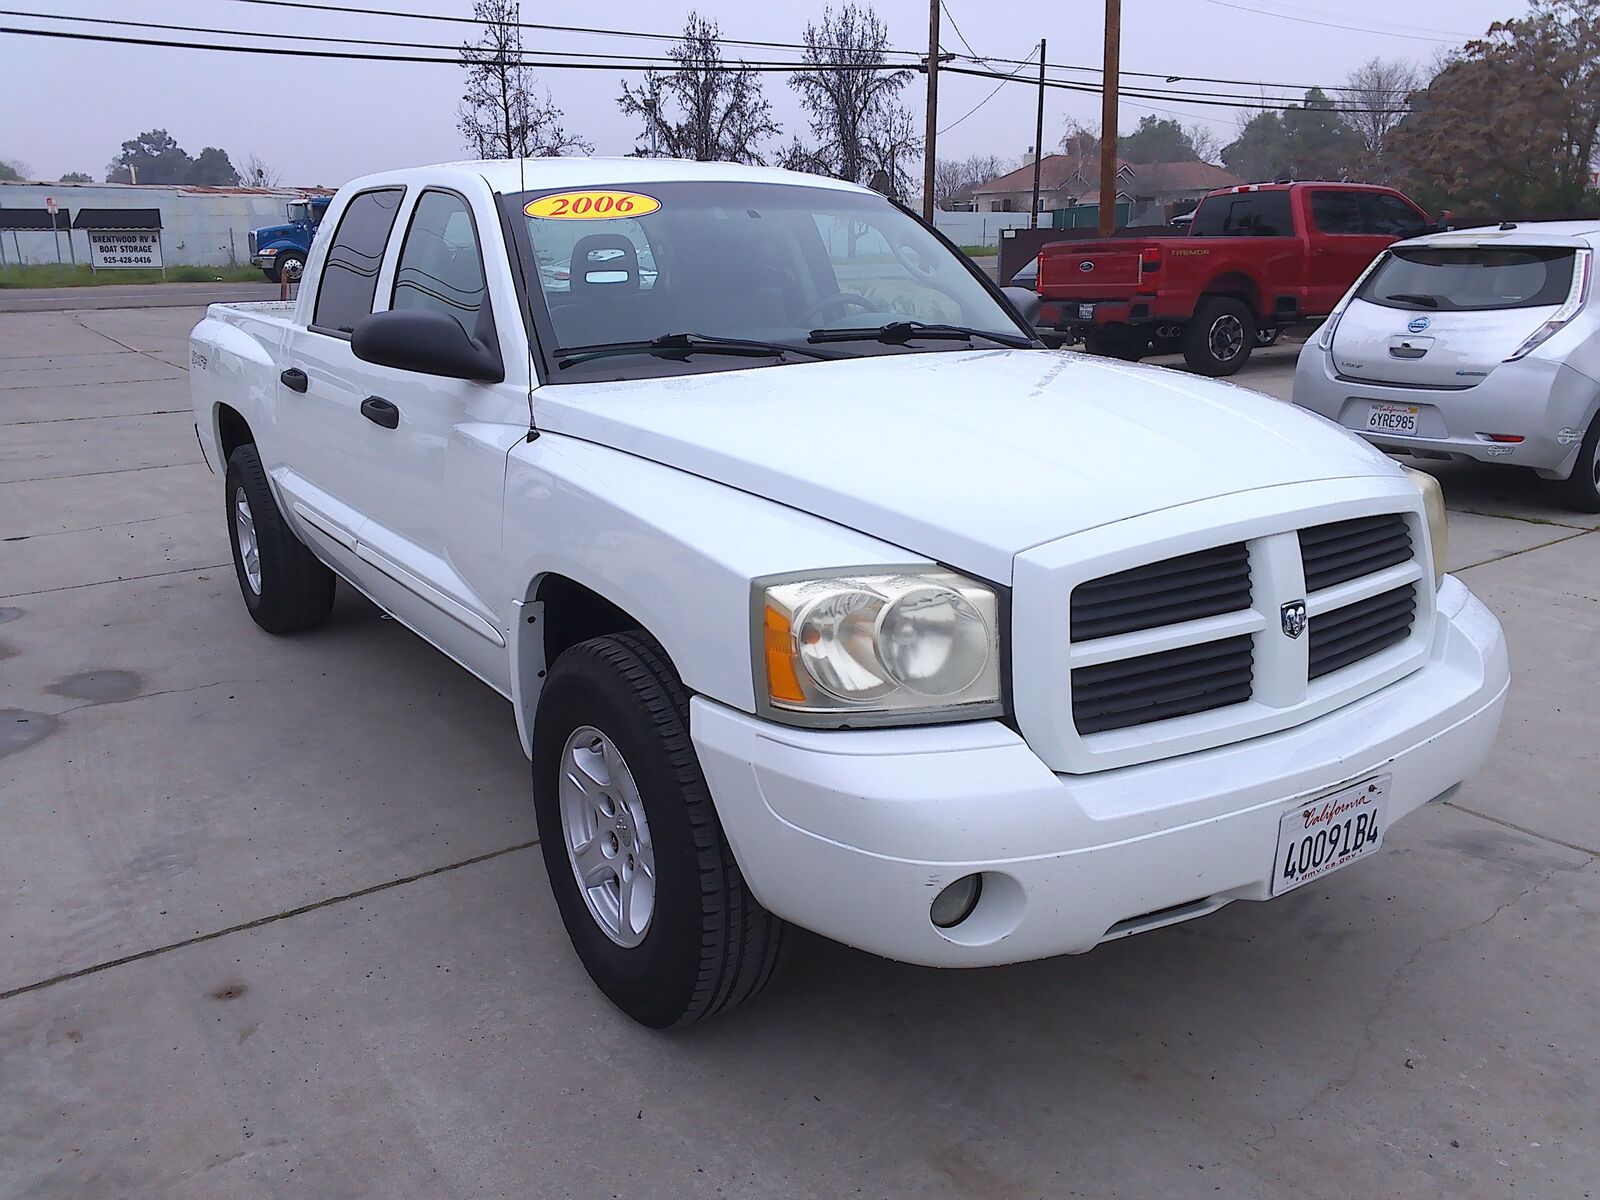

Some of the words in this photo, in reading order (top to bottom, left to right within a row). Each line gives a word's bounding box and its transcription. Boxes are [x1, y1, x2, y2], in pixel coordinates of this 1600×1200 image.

[549, 195, 635, 216] 2006
[92, 235, 137, 243] BRENTWOOD
[139, 235, 149, 243] RV
[151, 235, 158, 243] &
[99, 245, 117, 253] BOAT
[120, 245, 152, 253] STORAGE
[103, 256, 152, 264] 925-428-0416
[1379, 404, 1409, 414] California
[1370, 412, 1415, 430] 6YRE985
[1303, 794, 1372, 829] California
[1283, 808, 1378, 879] 40091B4
[1301, 852, 1357, 881] dmv.ca.gov
